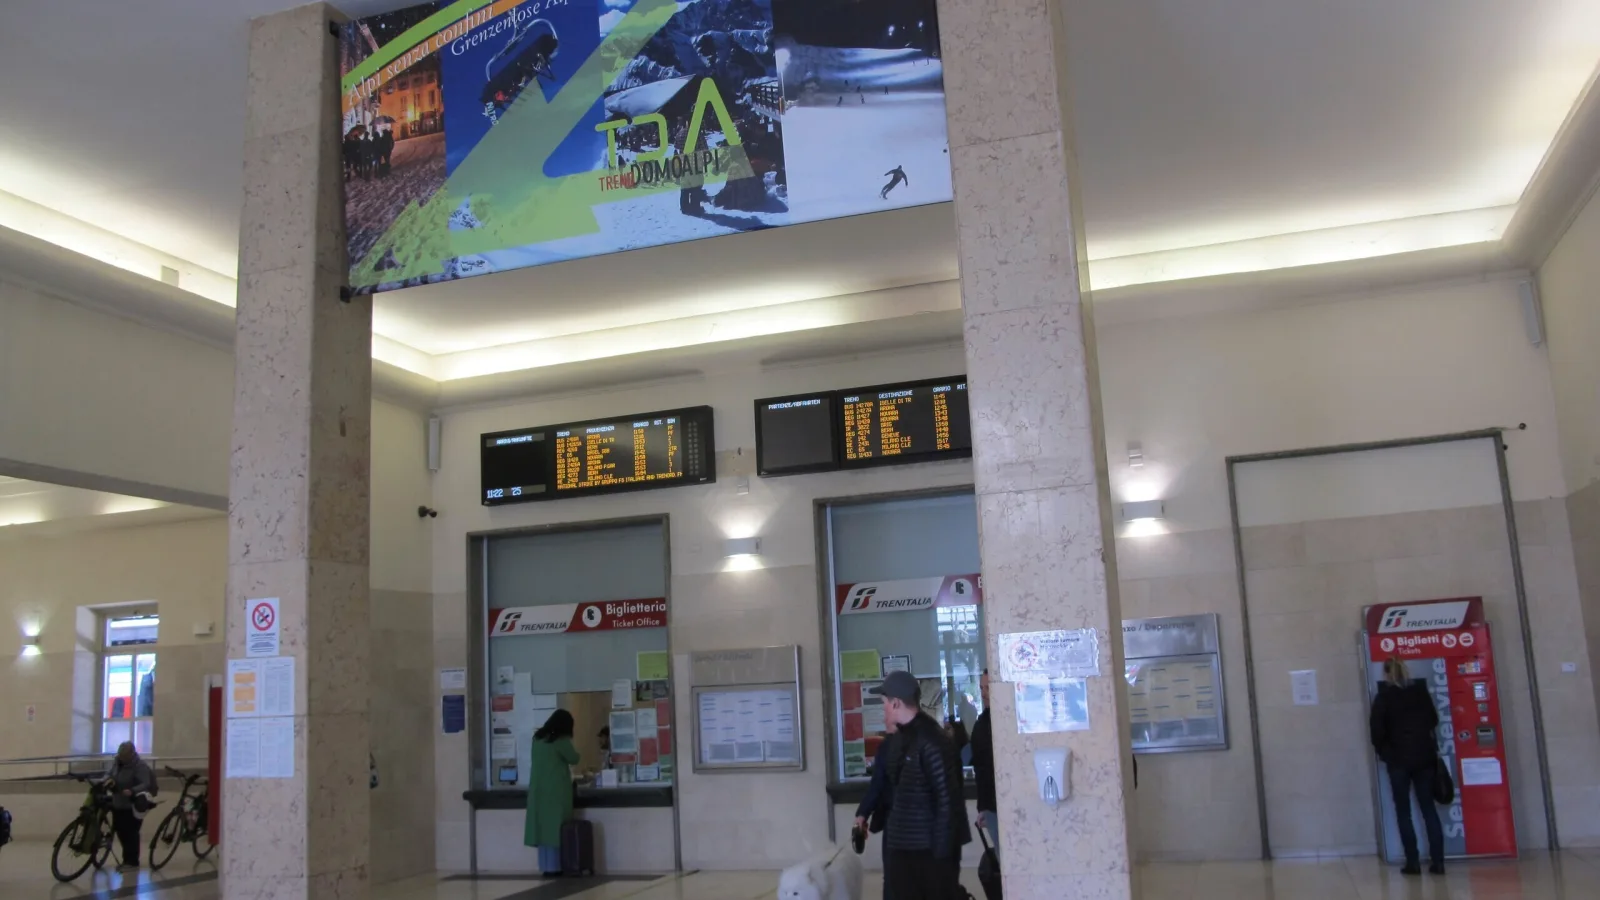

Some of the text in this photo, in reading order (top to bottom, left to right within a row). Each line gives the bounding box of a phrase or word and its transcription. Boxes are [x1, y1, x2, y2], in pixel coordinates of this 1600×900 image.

[451, 2, 541, 56] Grenzenlose
[349, 0, 494, 101] Alpi senza confini
[631, 148, 719, 187] DOMOALPI
[878, 390, 913, 399] DESTINAZIONE
[606, 601, 666, 617] Biglietteria
[876, 598, 932, 609] TRENITALIA
[520, 621, 567, 632] TRENITALIA
[612, 618, 660, 628] Ticket Office
[1406, 618, 1457, 628] TRENITALIA
[1397, 634, 1439, 647] Biglietti
[1432, 657, 1456, 756] Service
